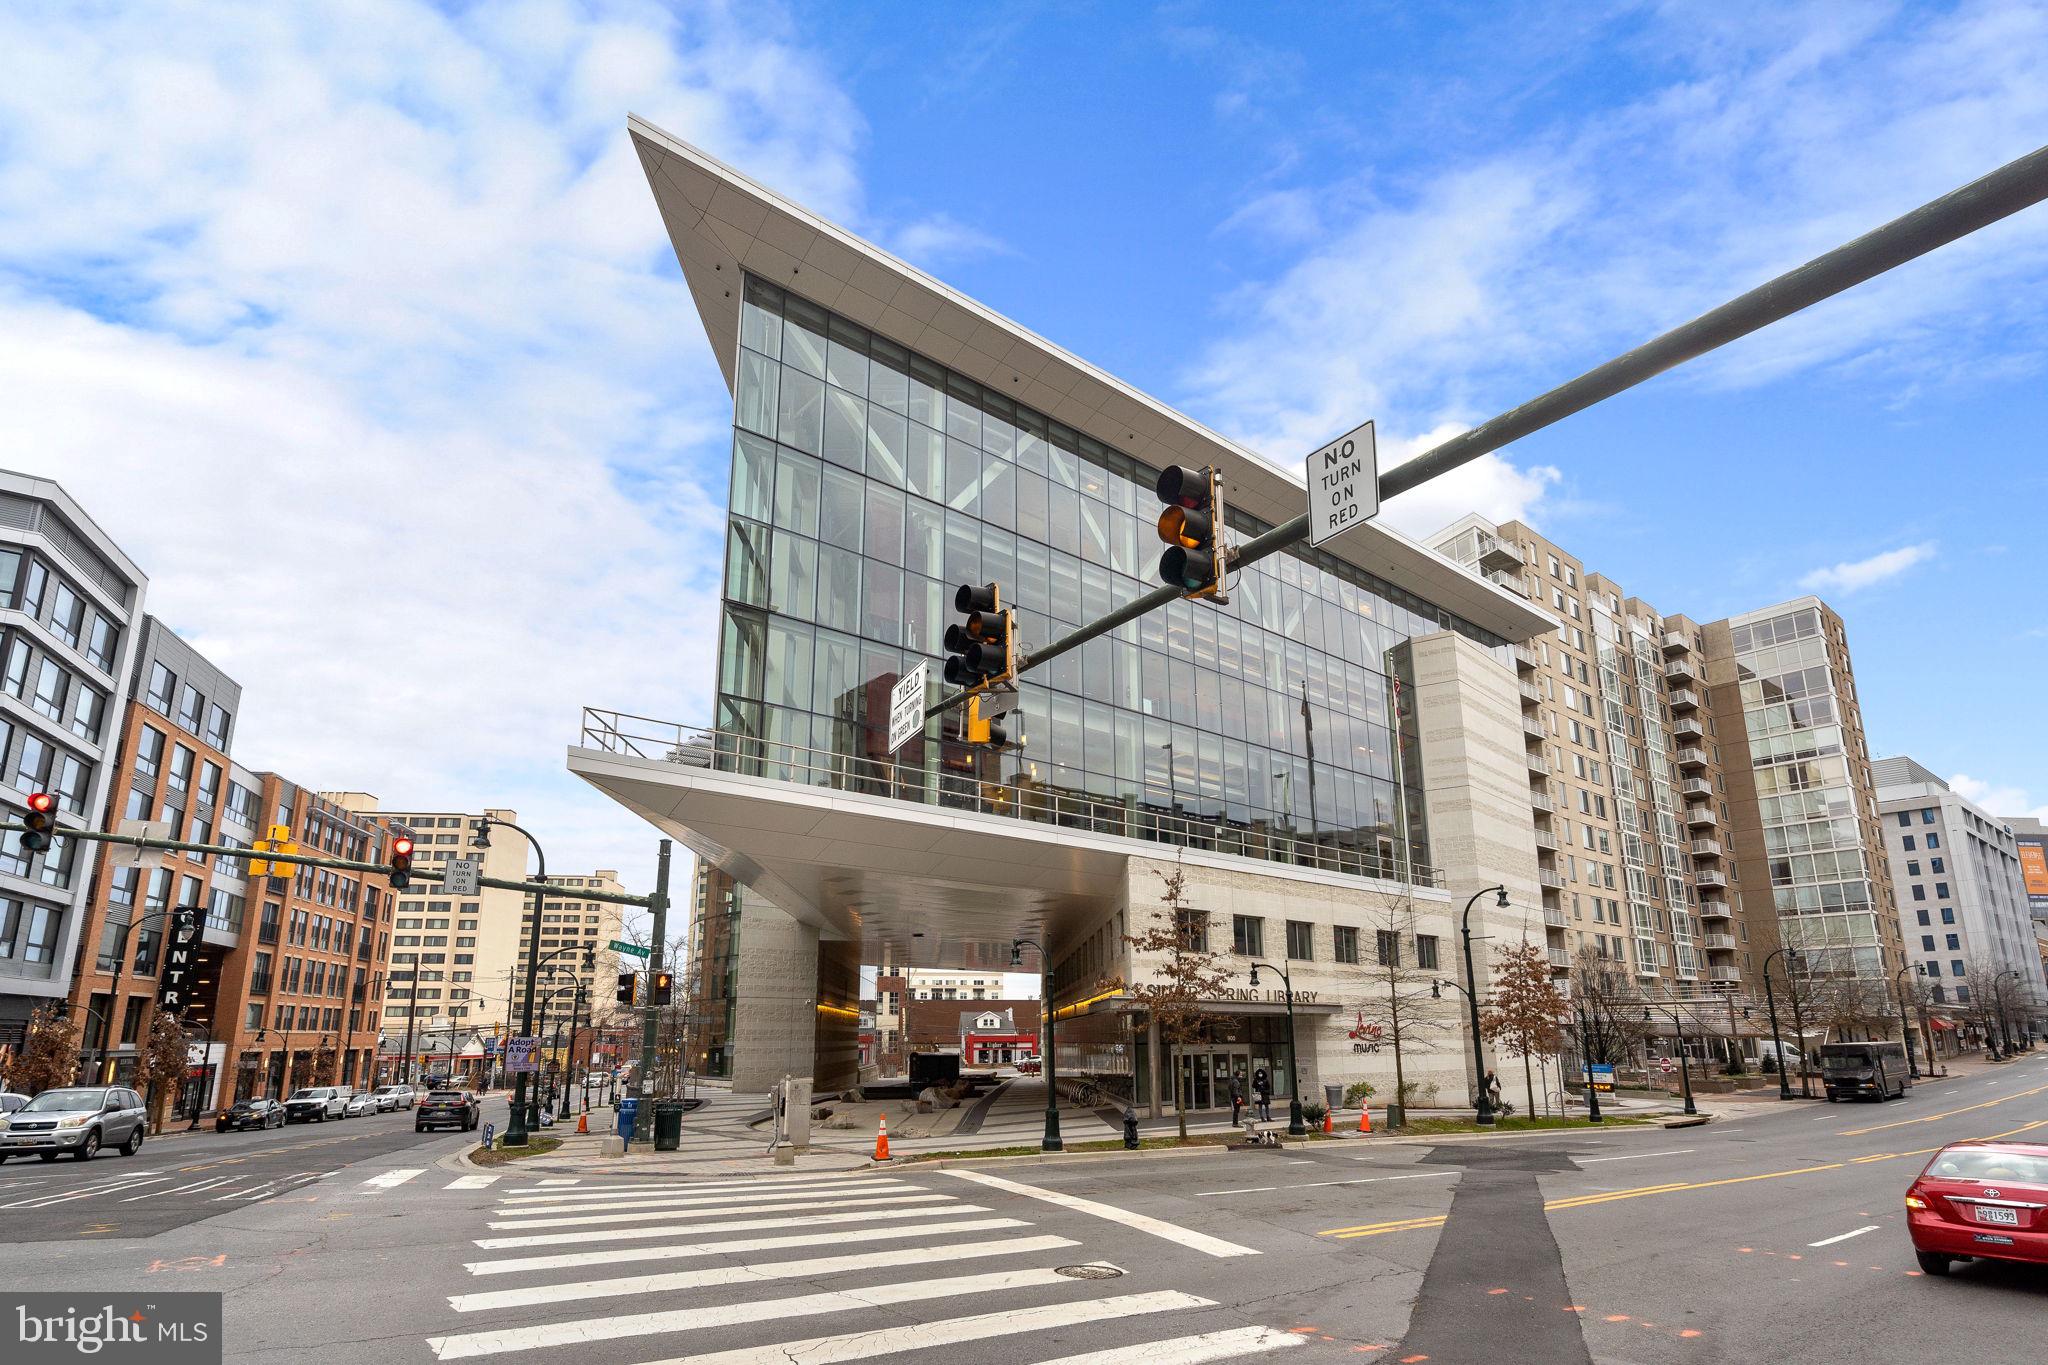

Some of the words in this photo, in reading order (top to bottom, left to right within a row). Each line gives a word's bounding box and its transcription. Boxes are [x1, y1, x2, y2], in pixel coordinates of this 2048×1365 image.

[1324, 439, 1355, 469] NO
[1321, 459, 1361, 490] TURN
[1331, 484, 1354, 506] ON
[1329, 503, 1358, 529] RED
[898, 672, 920, 700] YIELD
[613, 942, 635, 953] Wayne
[508, 1039, 535, 1047] Adopt
[516, 1046, 537, 1054] Road
